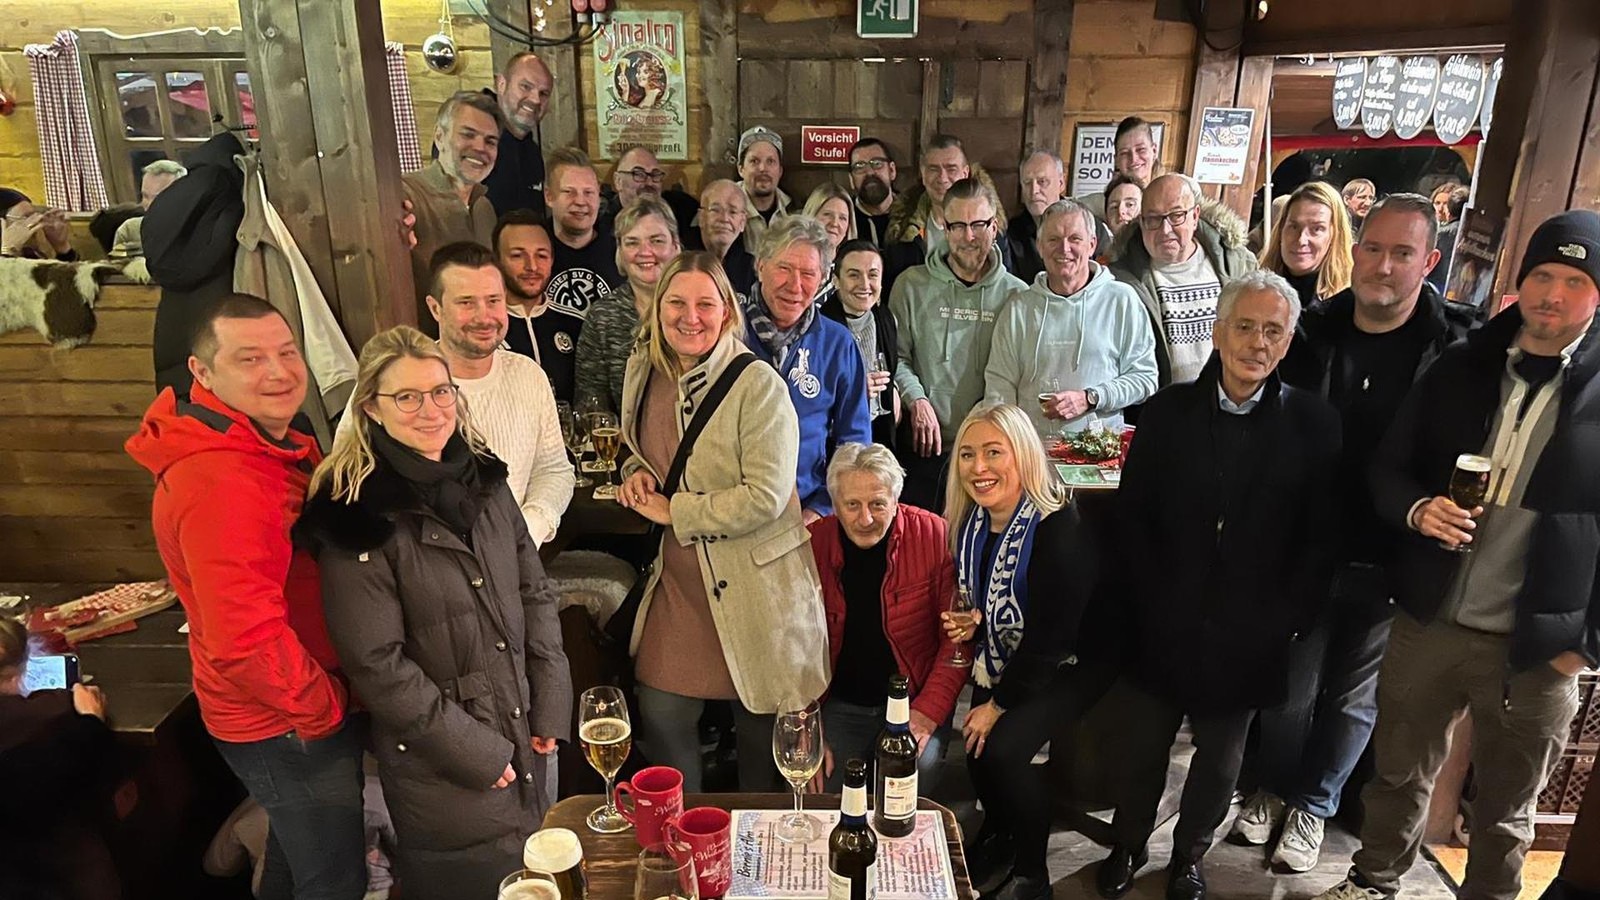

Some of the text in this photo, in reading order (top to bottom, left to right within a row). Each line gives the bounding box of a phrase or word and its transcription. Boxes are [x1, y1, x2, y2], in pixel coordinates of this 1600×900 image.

[808, 131, 853, 143] Vorsicht
[814, 147, 846, 157] Stufe!
[1078, 168, 1102, 179] SO
[547, 274, 568, 300] ICHER
[572, 271, 584, 279] SV
